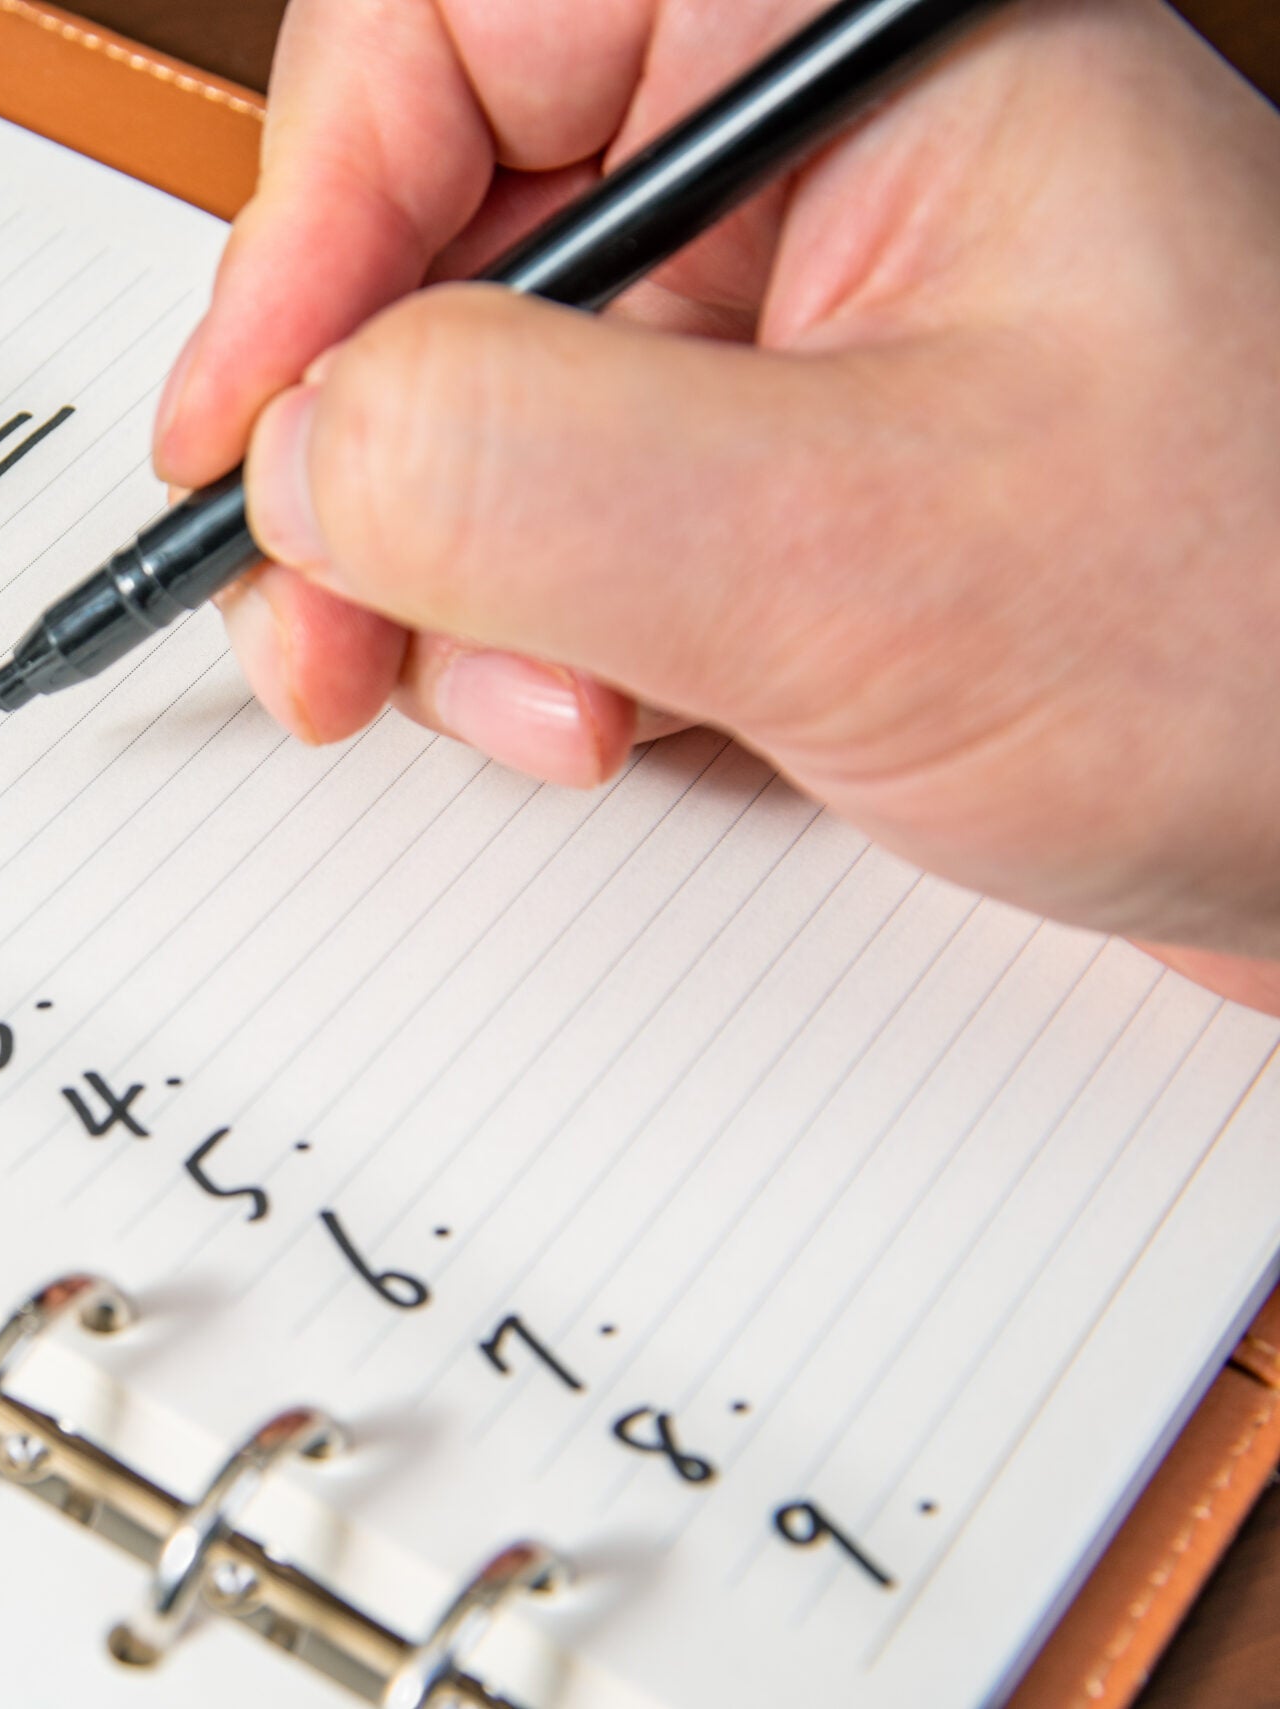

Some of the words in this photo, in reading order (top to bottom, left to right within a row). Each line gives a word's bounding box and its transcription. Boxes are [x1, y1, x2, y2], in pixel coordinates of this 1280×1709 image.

[60, 1070, 182, 1138] 4.
[184, 1126, 310, 1222] 5.
[320, 1210, 451, 1310] 6.
[477, 1313, 615, 1392] 7.
[612, 1402, 748, 1486] 8.
[772, 1499, 935, 1588] 9.
